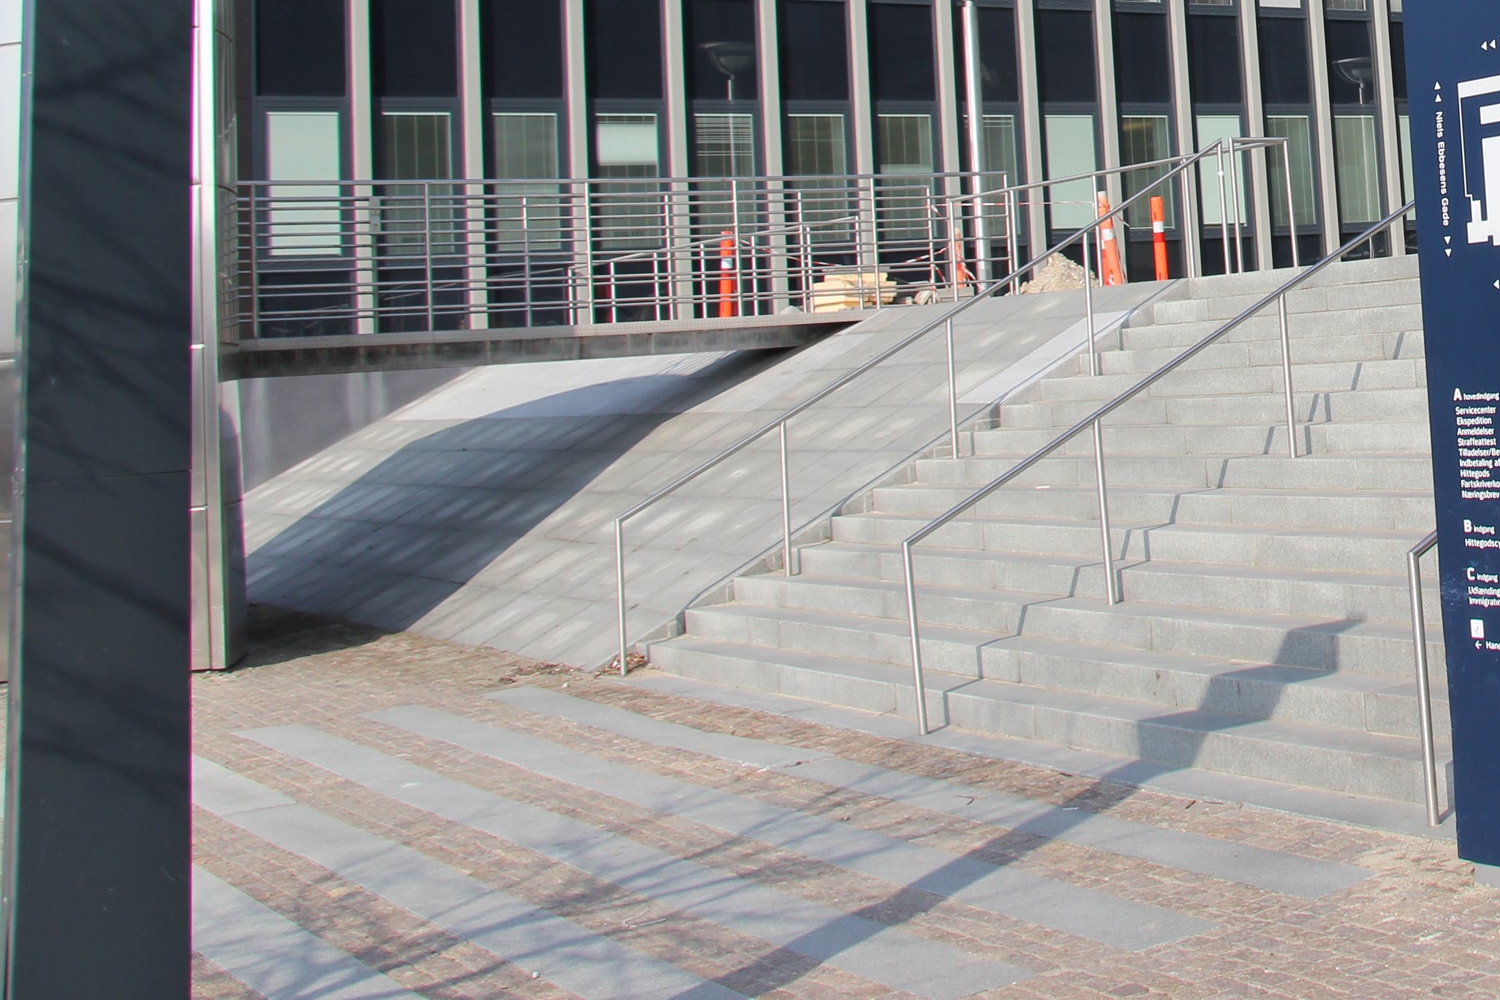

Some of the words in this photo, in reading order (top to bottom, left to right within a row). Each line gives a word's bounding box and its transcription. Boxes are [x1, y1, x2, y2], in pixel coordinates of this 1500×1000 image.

[1435, 111, 1444, 139] Niels
[1437, 141, 1447, 195] Ebbesens
[1441, 197, 1450, 226] Gade
[1453, 387, 1462, 401] A
[1455, 405, 1497, 416] Servicecenter
[1456, 416, 1493, 427] Ekspedition
[1456, 426, 1495, 436] Anmeldelser
[1457, 437, 1497, 447] Straffeattest
[1459, 458, 1493, 469] Indbetaling
[1493, 458, 1500, 467] af
[1459, 469, 1491, 480] Hittegods
[1461, 490, 1500, 501] Næringsbrev
[1463, 519, 1472, 533] B
[1466, 567, 1475, 581] C
